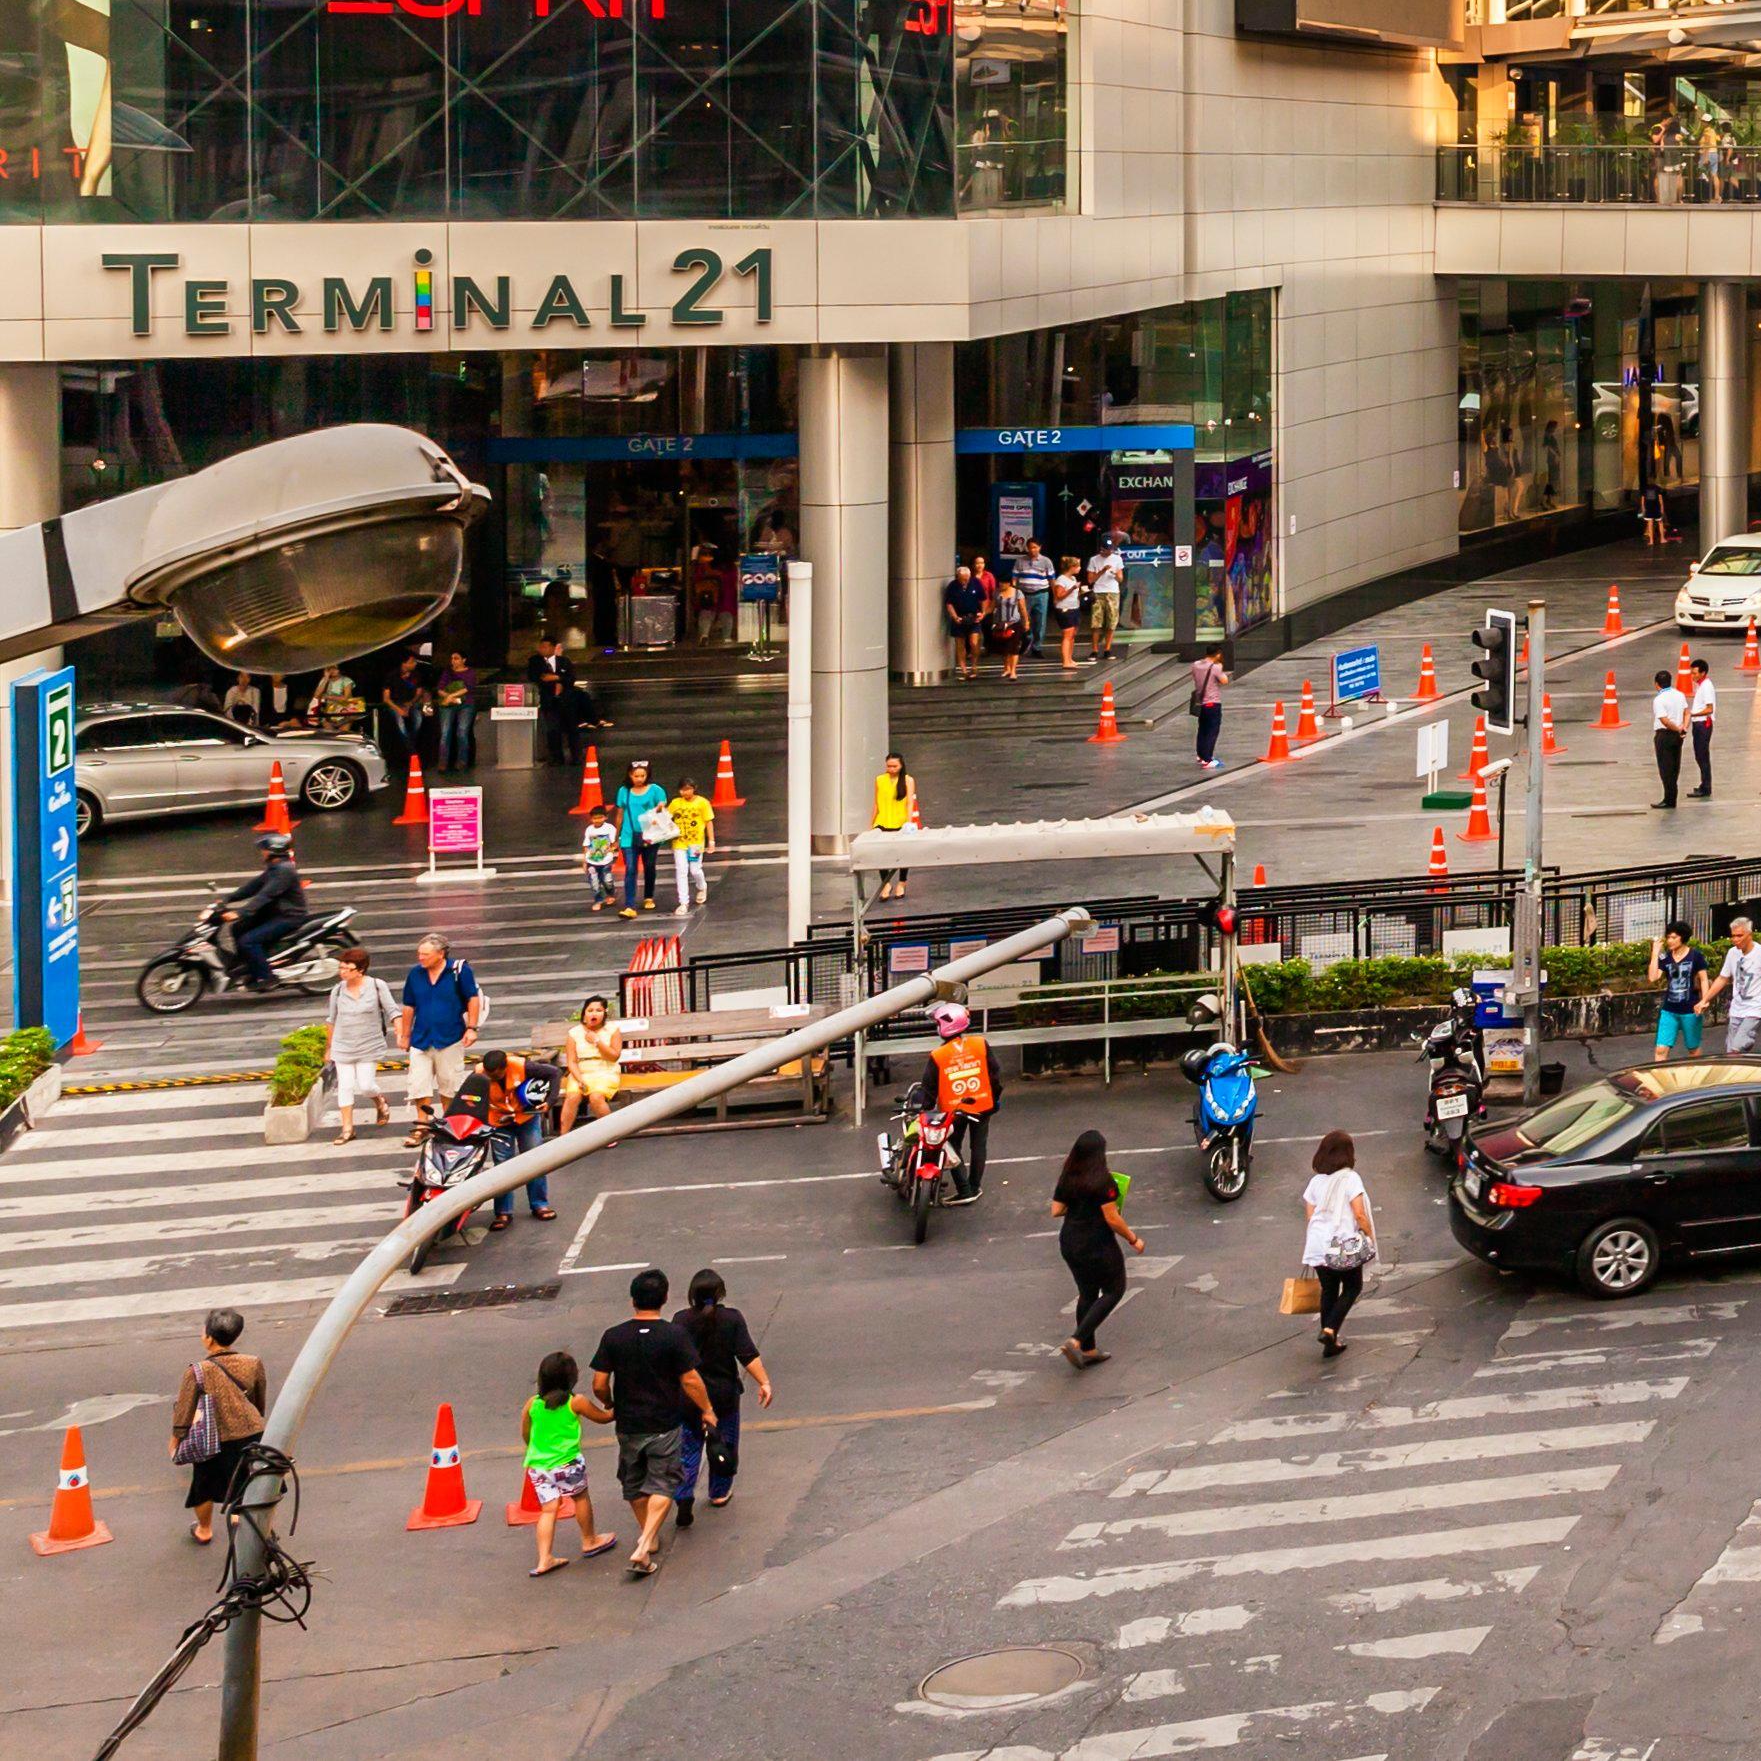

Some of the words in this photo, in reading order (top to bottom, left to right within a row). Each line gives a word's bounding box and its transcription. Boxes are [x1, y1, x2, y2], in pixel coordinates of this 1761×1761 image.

[670, 247, 773, 325] 21
[628, 437, 678, 455] GATE
[682, 436, 694, 451] 2
[998, 430, 1049, 446] GATE
[1051, 430, 1061, 445] 2
[1118, 476, 1173, 489] EXCHAN
[52, 718, 66, 767] 2
